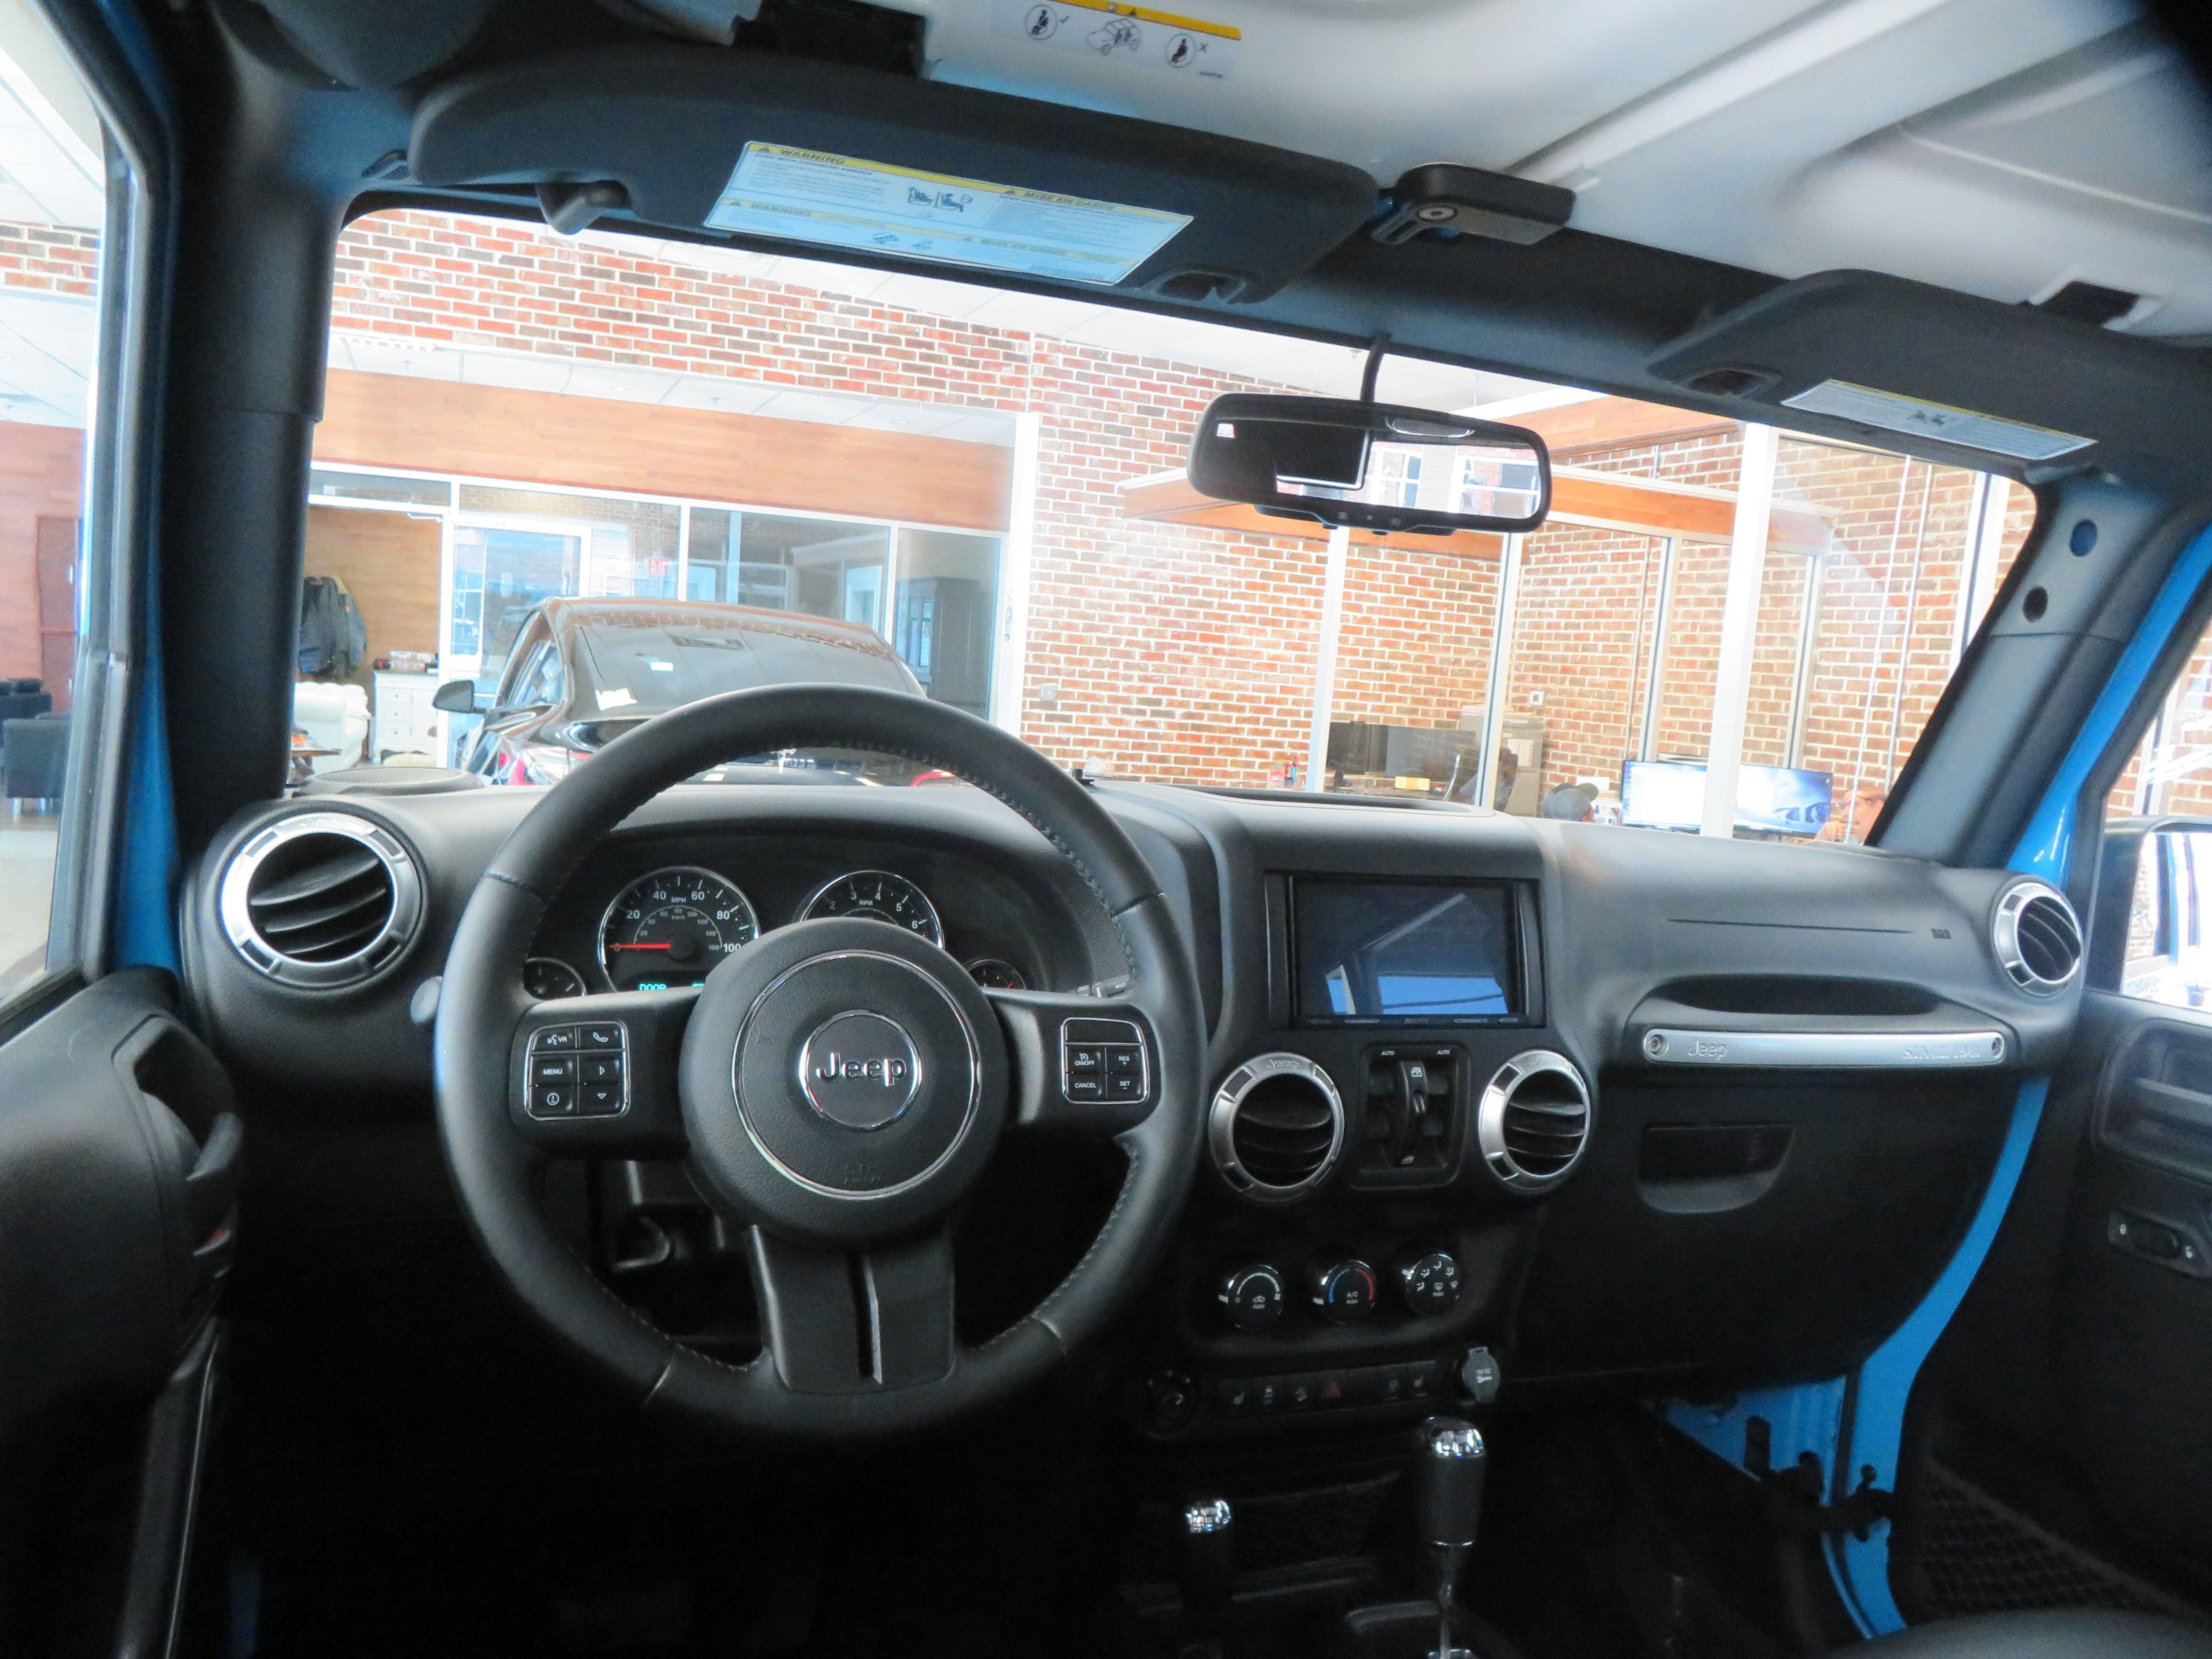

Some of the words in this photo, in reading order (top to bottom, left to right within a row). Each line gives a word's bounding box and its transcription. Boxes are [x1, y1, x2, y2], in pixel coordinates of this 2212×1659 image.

[780, 149, 845, 164] WARNING
[653, 891, 667, 900] 40
[691, 891, 704, 901] 60
[851, 892, 857, 900] 3
[875, 892, 881, 900] 4
[830, 902, 835, 910] 2
[896, 903, 902, 911] 5
[626, 910, 640, 919] 20
[717, 910, 730, 920] 80
[911, 920, 918, 929] 6
[723, 943, 742, 953] 100
[1688, 1040, 1727, 1060] Jeep
[815, 1052, 907, 1087] Jeep
